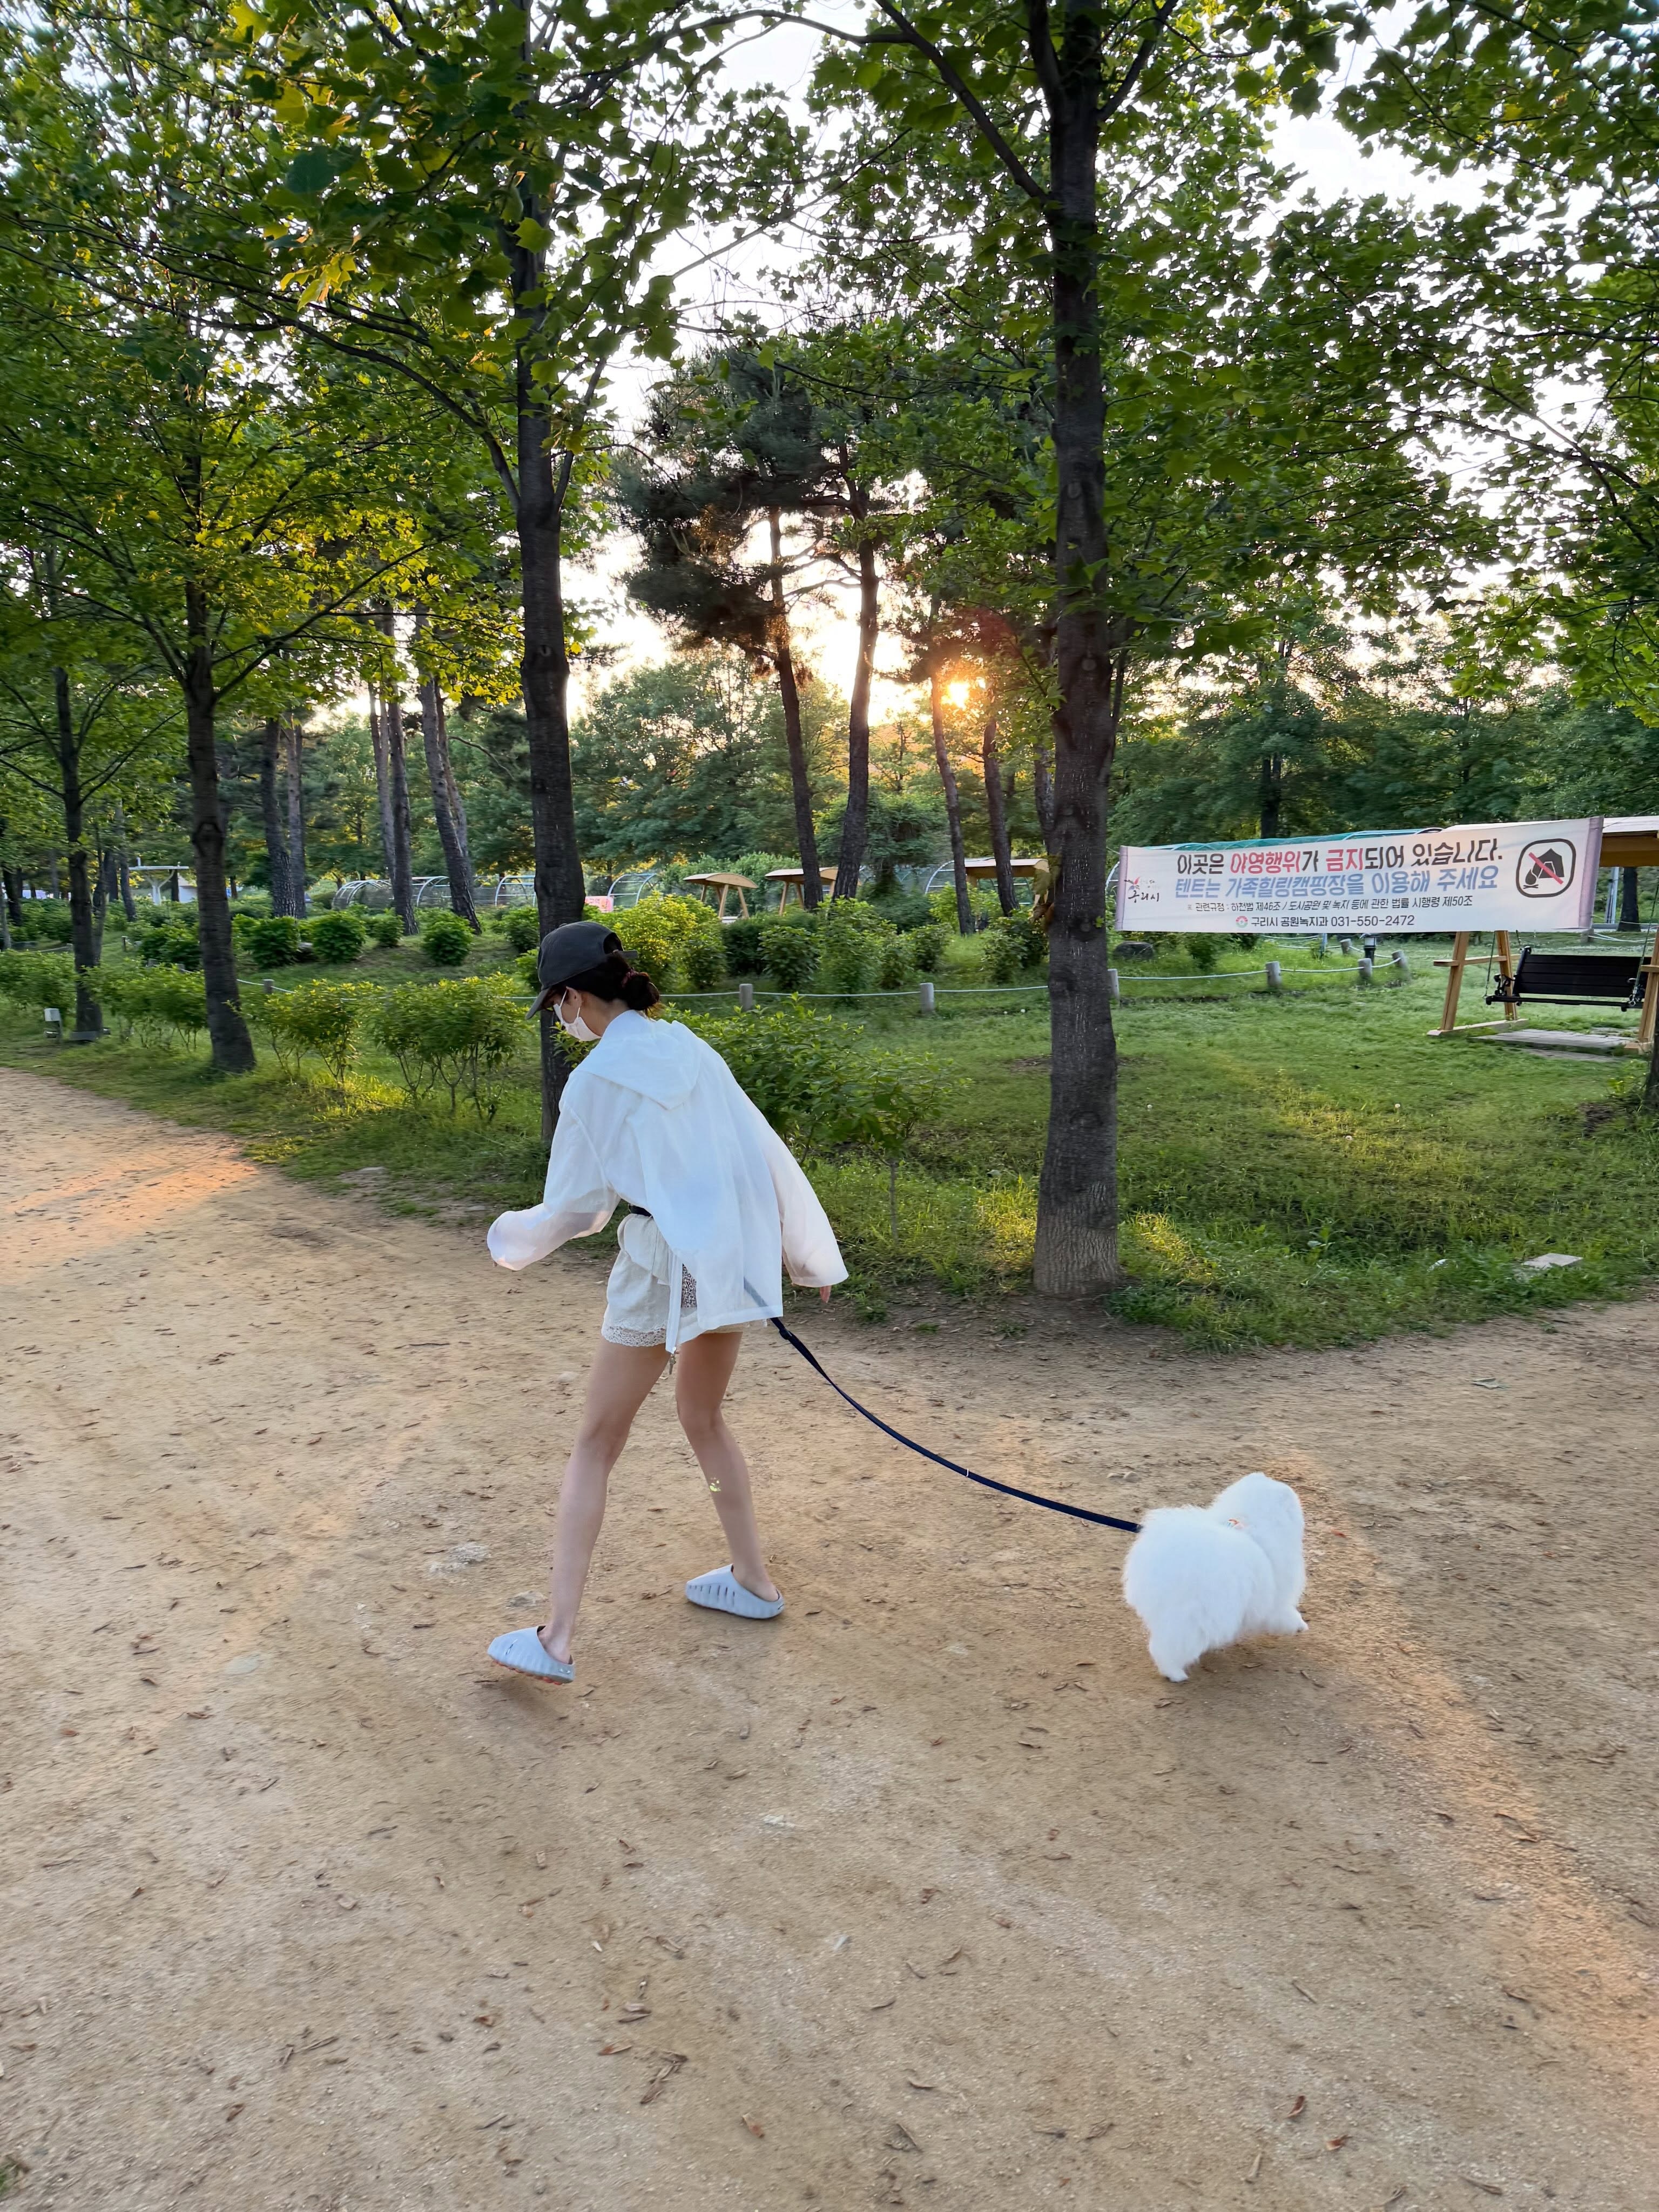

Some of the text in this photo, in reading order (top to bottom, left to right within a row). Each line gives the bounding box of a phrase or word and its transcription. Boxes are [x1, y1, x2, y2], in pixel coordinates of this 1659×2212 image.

[1177, 838, 1502, 875] 이곳은 야영행위가 금지되어 있습니다.
[1175, 865, 1499, 898] 텐트는 가족힐링캠핑장을 이용해 주세요
[1195, 902, 1225, 912] 관련규정
[1231, 902, 1253, 912] 하천법
[1256, 901, 1281, 911] 제46조
[1288, 900, 1321, 911] 도시공원
[1321, 900, 1332, 910] 및
[1332, 900, 1350, 909] 녹지
[1351, 899, 1369, 909] 등에
[1371, 899, 1388, 909] 관한
[1412, 896, 1440, 908] 시행령
[1442, 895, 1473, 907] 제50조
[1251, 915, 1415, 927] 구리시 공원녹지과 031-550-2472
